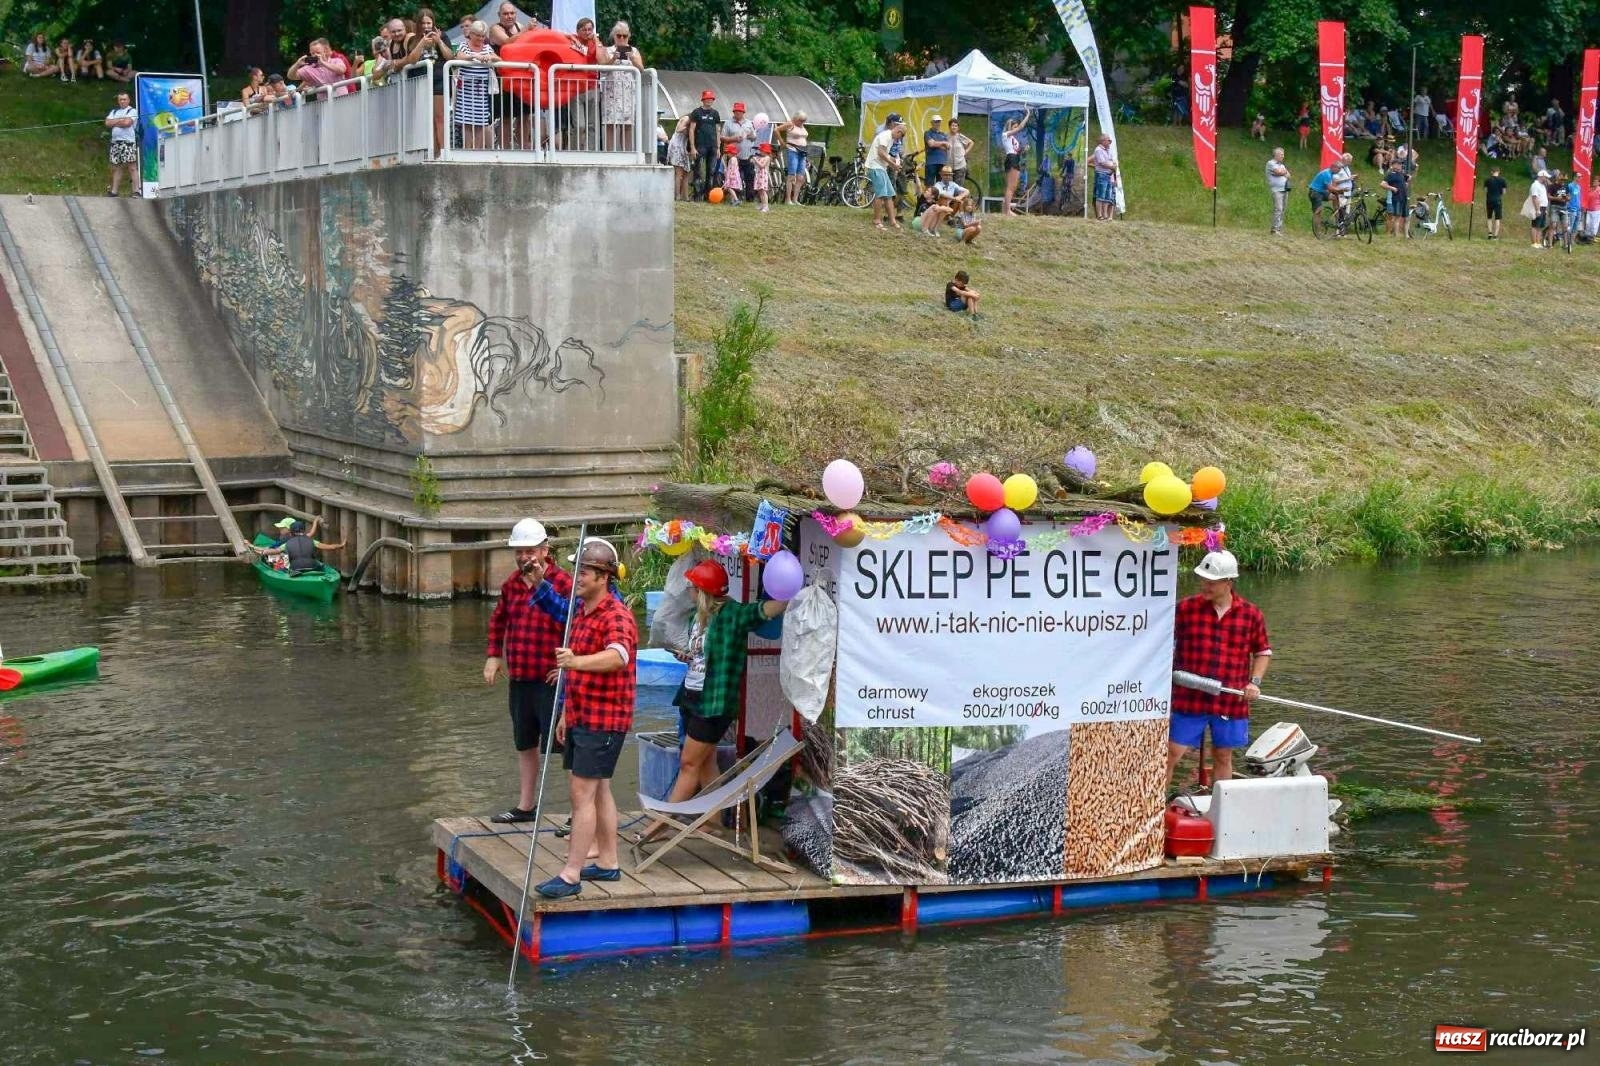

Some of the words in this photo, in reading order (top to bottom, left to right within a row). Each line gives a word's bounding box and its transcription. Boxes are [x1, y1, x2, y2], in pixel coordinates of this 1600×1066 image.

[855, 549, 974, 600] SKLEP
[987, 550, 1030, 599] PE
[1043, 550, 1102, 599] GIE
[1114, 549, 1169, 597] GIE
[876, 609, 1148, 637] www.i-tak-nic-nie-kupisz.pl
[858, 685, 929, 703] darmowy
[973, 683, 1056, 701] ekogroszek
[1107, 680, 1142, 697] pellet
[867, 704, 915, 720] chrust
